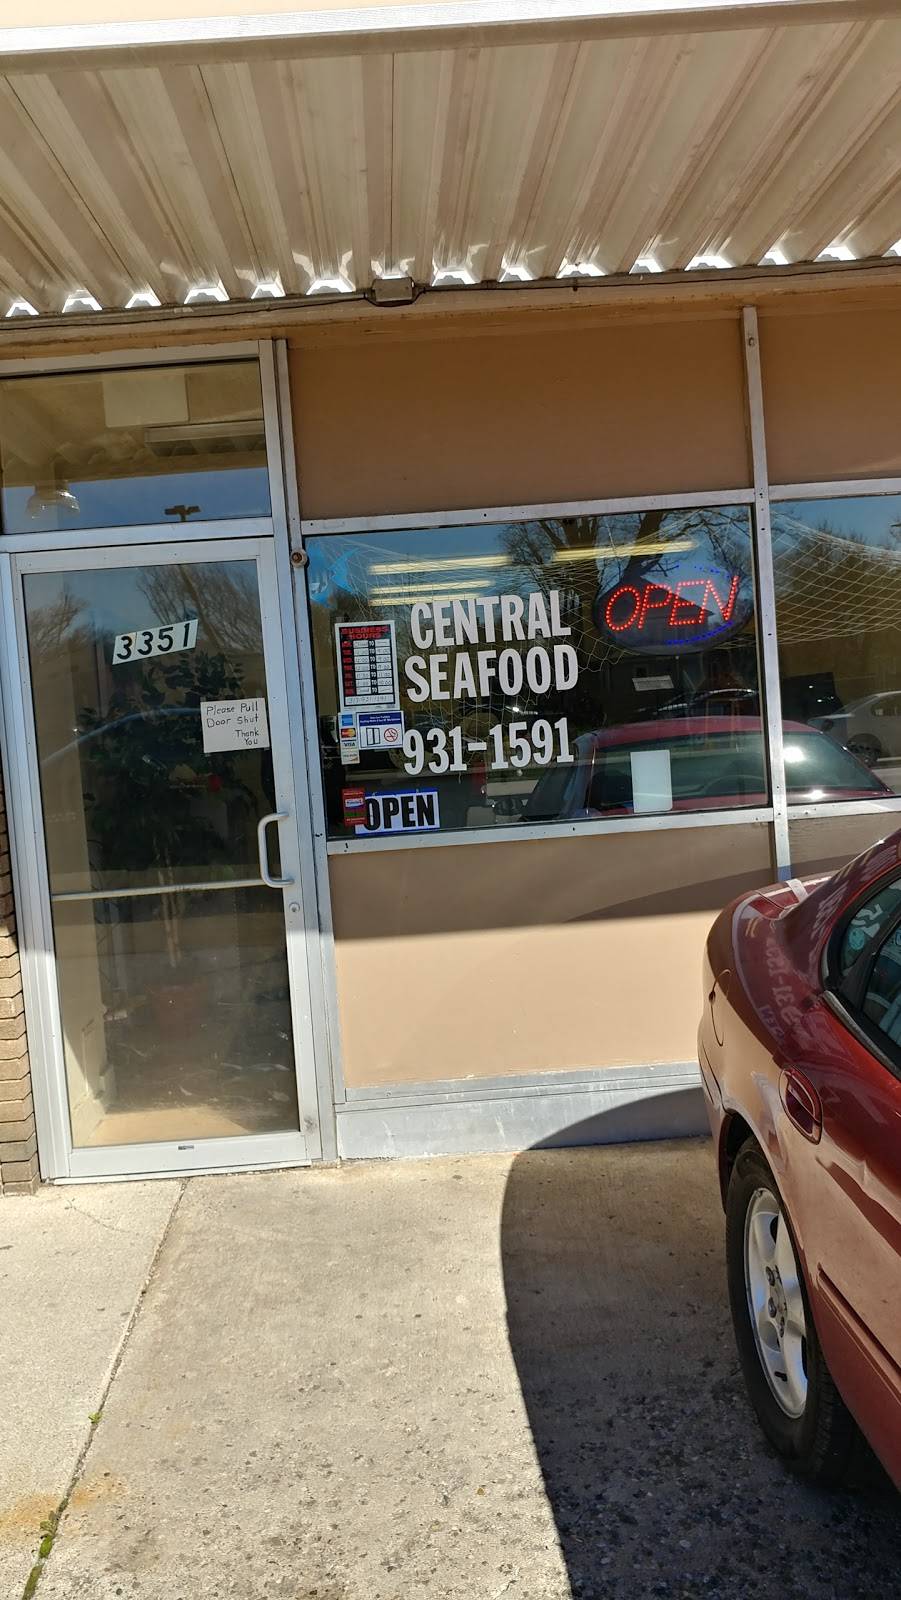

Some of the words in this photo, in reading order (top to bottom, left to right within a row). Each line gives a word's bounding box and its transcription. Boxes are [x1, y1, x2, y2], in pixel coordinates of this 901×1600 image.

[410, 589, 572, 650] CENTRAL
[605, 575, 739, 632] OPEN
[116, 622, 191, 660] 3351
[404, 645, 579, 703] SEAFOOD
[206, 705, 236, 716] Please
[240, 701, 258, 713] Pull
[206, 717, 232, 729] Door
[236, 714, 259, 725] Shut
[235, 727, 260, 738] Thank
[244, 737, 258, 746] You
[402, 717, 575, 776] 931-1591
[364, 794, 435, 831] OPEN
